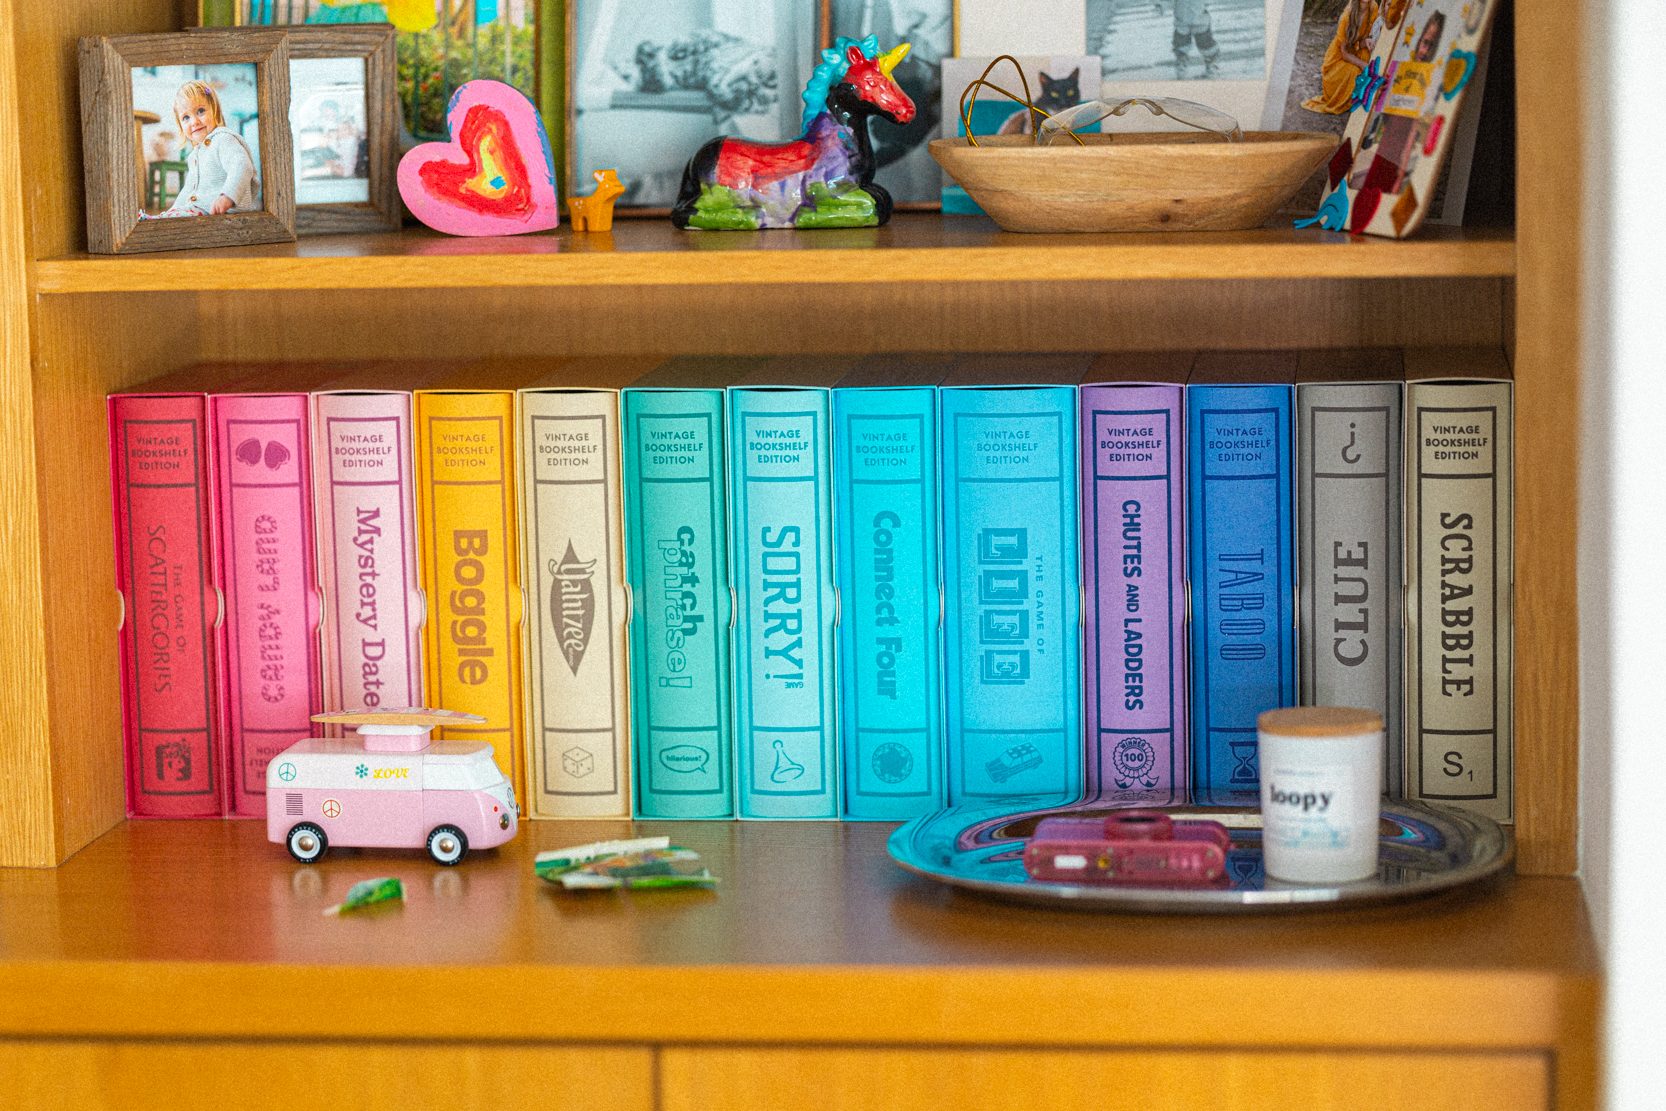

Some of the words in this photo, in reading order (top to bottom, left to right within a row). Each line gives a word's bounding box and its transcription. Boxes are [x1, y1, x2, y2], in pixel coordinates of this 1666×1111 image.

[756, 430, 800, 438] VINTAGE
[1107, 428, 1153, 437] VINTAGE
[1216, 428, 1263, 436] VINTAGE
[1433, 425, 1480, 434] VINTAGE
[340, 434, 384, 443] VINTAGE
[442, 434, 486, 442] VINTAGE
[545, 433, 589, 442] VINTAGE
[651, 431, 695, 440] VINTAGE
[862, 433, 907, 442] VINTAGE
[984, 431, 1030, 439] VINTAGE
[136, 437, 180, 446] VINTAGE
[1101, 440, 1162, 449] BOOKSHELF
[1209, 440, 1271, 449] BOOKSHELF
[1426, 438, 1488, 447] BOOKSHELF
[335, 446, 392, 455] BOOKSHELF
[436, 446, 494, 455] BOOKSHELF
[539, 445, 598, 454] BOOKSHELF
[645, 443, 703, 452] BOOKSHELF
[750, 442, 808, 451] BOOKSHELF
[856, 445, 916, 454] BOOKSHELF
[977, 443, 1038, 452] BOOKSHELF
[132, 449, 188, 458] BOOKSHELF
[1109, 453, 1152, 462] EDITION
[1218, 453, 1262, 461] EDITION
[1435, 451, 1478, 460] EDITION
[445, 459, 486, 467] EDITION
[548, 458, 589, 466] EDITION
[653, 456, 694, 464] EDITION
[758, 454, 800, 463] EDITION
[865, 458, 906, 466] EDITION
[986, 455, 1029, 464] EDITION
[139, 462, 180, 470] EDITION
[343, 460, 383, 468] EDITION
[1122, 499, 1142, 578] CHUTES
[355, 506, 382, 633] Mystery
[871, 510, 901, 627] Connect
[1035, 554, 1044, 582] THE
[677, 525, 704, 637] catch
[1126, 583, 1140, 612] AND
[450, 529, 494, 685] Boggle
[548, 558, 597, 652] Yahtzee
[761, 525, 804, 680] SORRY!
[984, 530, 1027, 681] LIFE
[1218, 548, 1266, 661] TABOO
[1333, 540, 1370, 666] CLUE
[1439, 512, 1474, 698] SCRABBLE
[147, 524, 172, 693] SCATTERGORIES
[174, 594, 185, 630] GAME
[1036, 590, 1044, 630] GAME
[658, 539, 693, 690] phrase!
[1036, 638, 1044, 655] OF
[874, 637, 902, 700] Four
[1124, 617, 1144, 711] LADDERS
[360, 638, 386, 707] Date
[1120, 740, 1146, 749] WINNER
[1124, 753, 1144, 762] 100
[373, 768, 410, 778] LOVE
[1270, 784, 1333, 812] loopy
